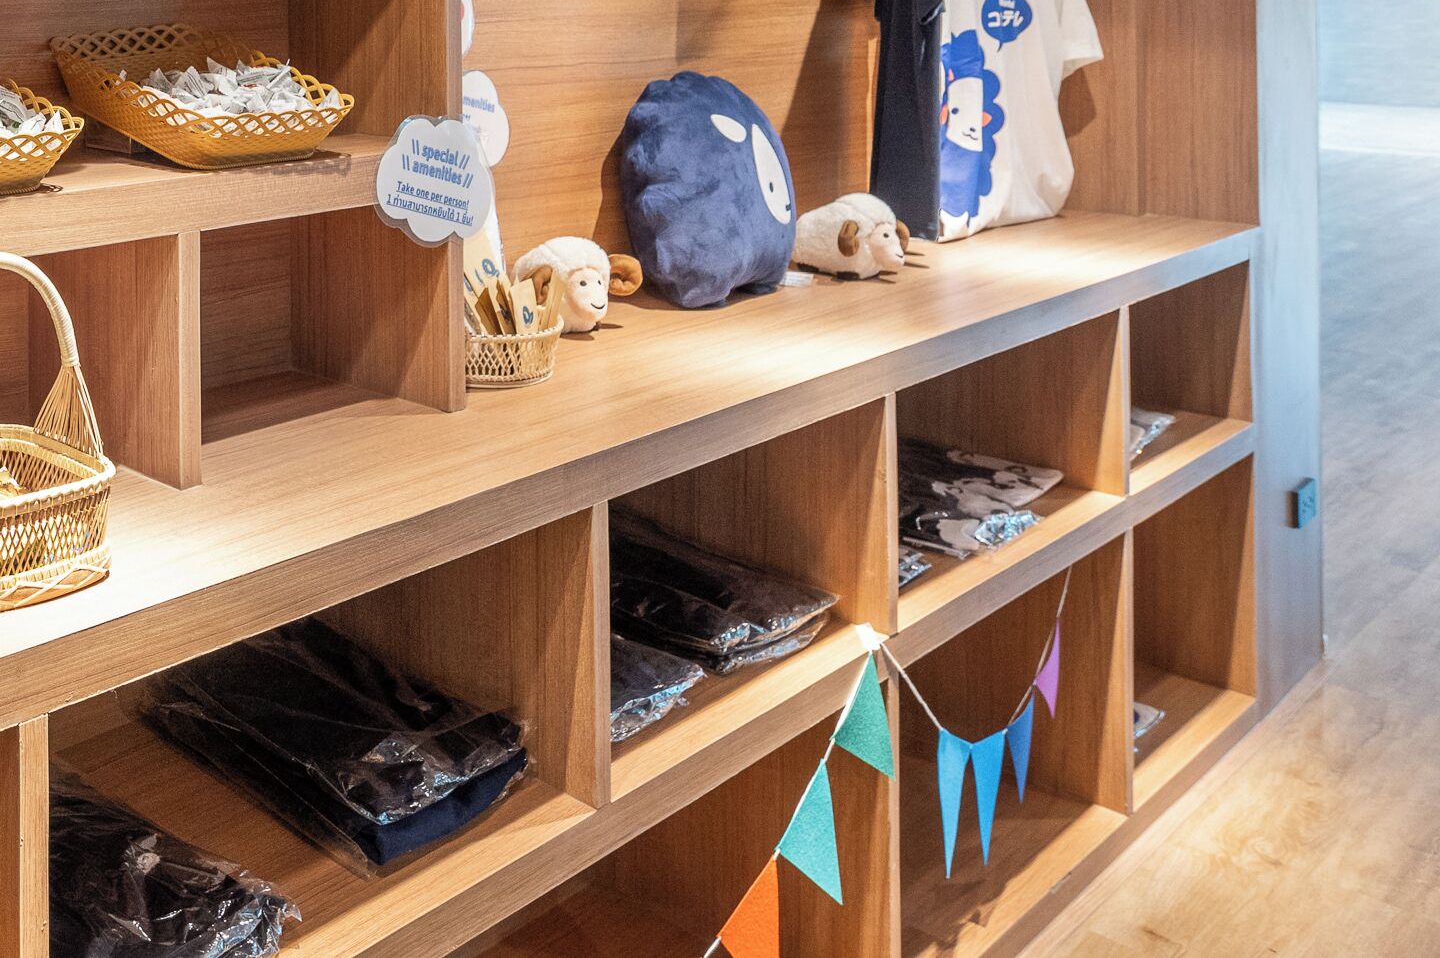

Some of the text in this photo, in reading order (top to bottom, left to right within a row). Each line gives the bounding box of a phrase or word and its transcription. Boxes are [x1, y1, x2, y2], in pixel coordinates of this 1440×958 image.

[463, 96, 495, 113] menities
[422, 145, 459, 167] special
[412, 160, 463, 185] amenities
[386, 194, 391, 204] 1
[397, 181, 469, 210] Take one per person!
